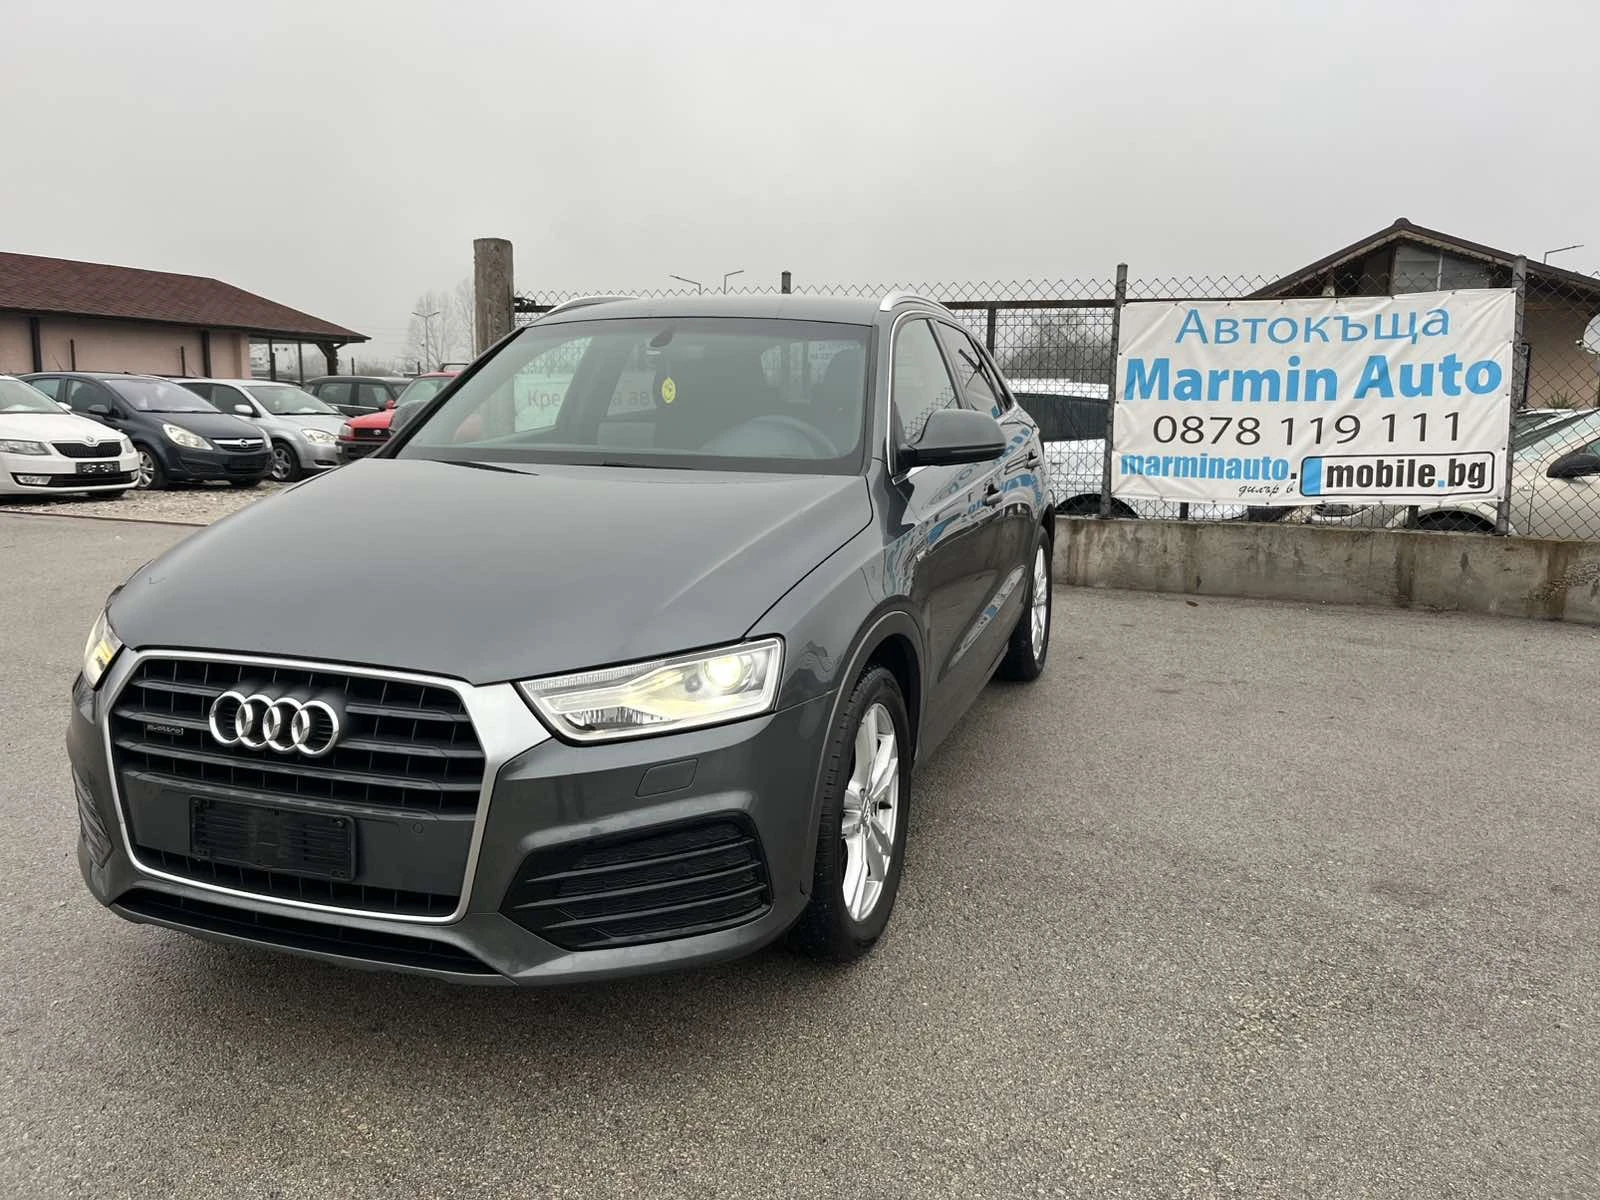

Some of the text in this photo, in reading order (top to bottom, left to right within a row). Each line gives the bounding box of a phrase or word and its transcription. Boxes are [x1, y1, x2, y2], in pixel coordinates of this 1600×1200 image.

[1175, 306, 1449, 345] Автокъща
[1124, 353, 1502, 402] Marmin Auto
[1152, 411, 1461, 446] 0878 119 111
[1326, 459, 1486, 489] mobile.bg
